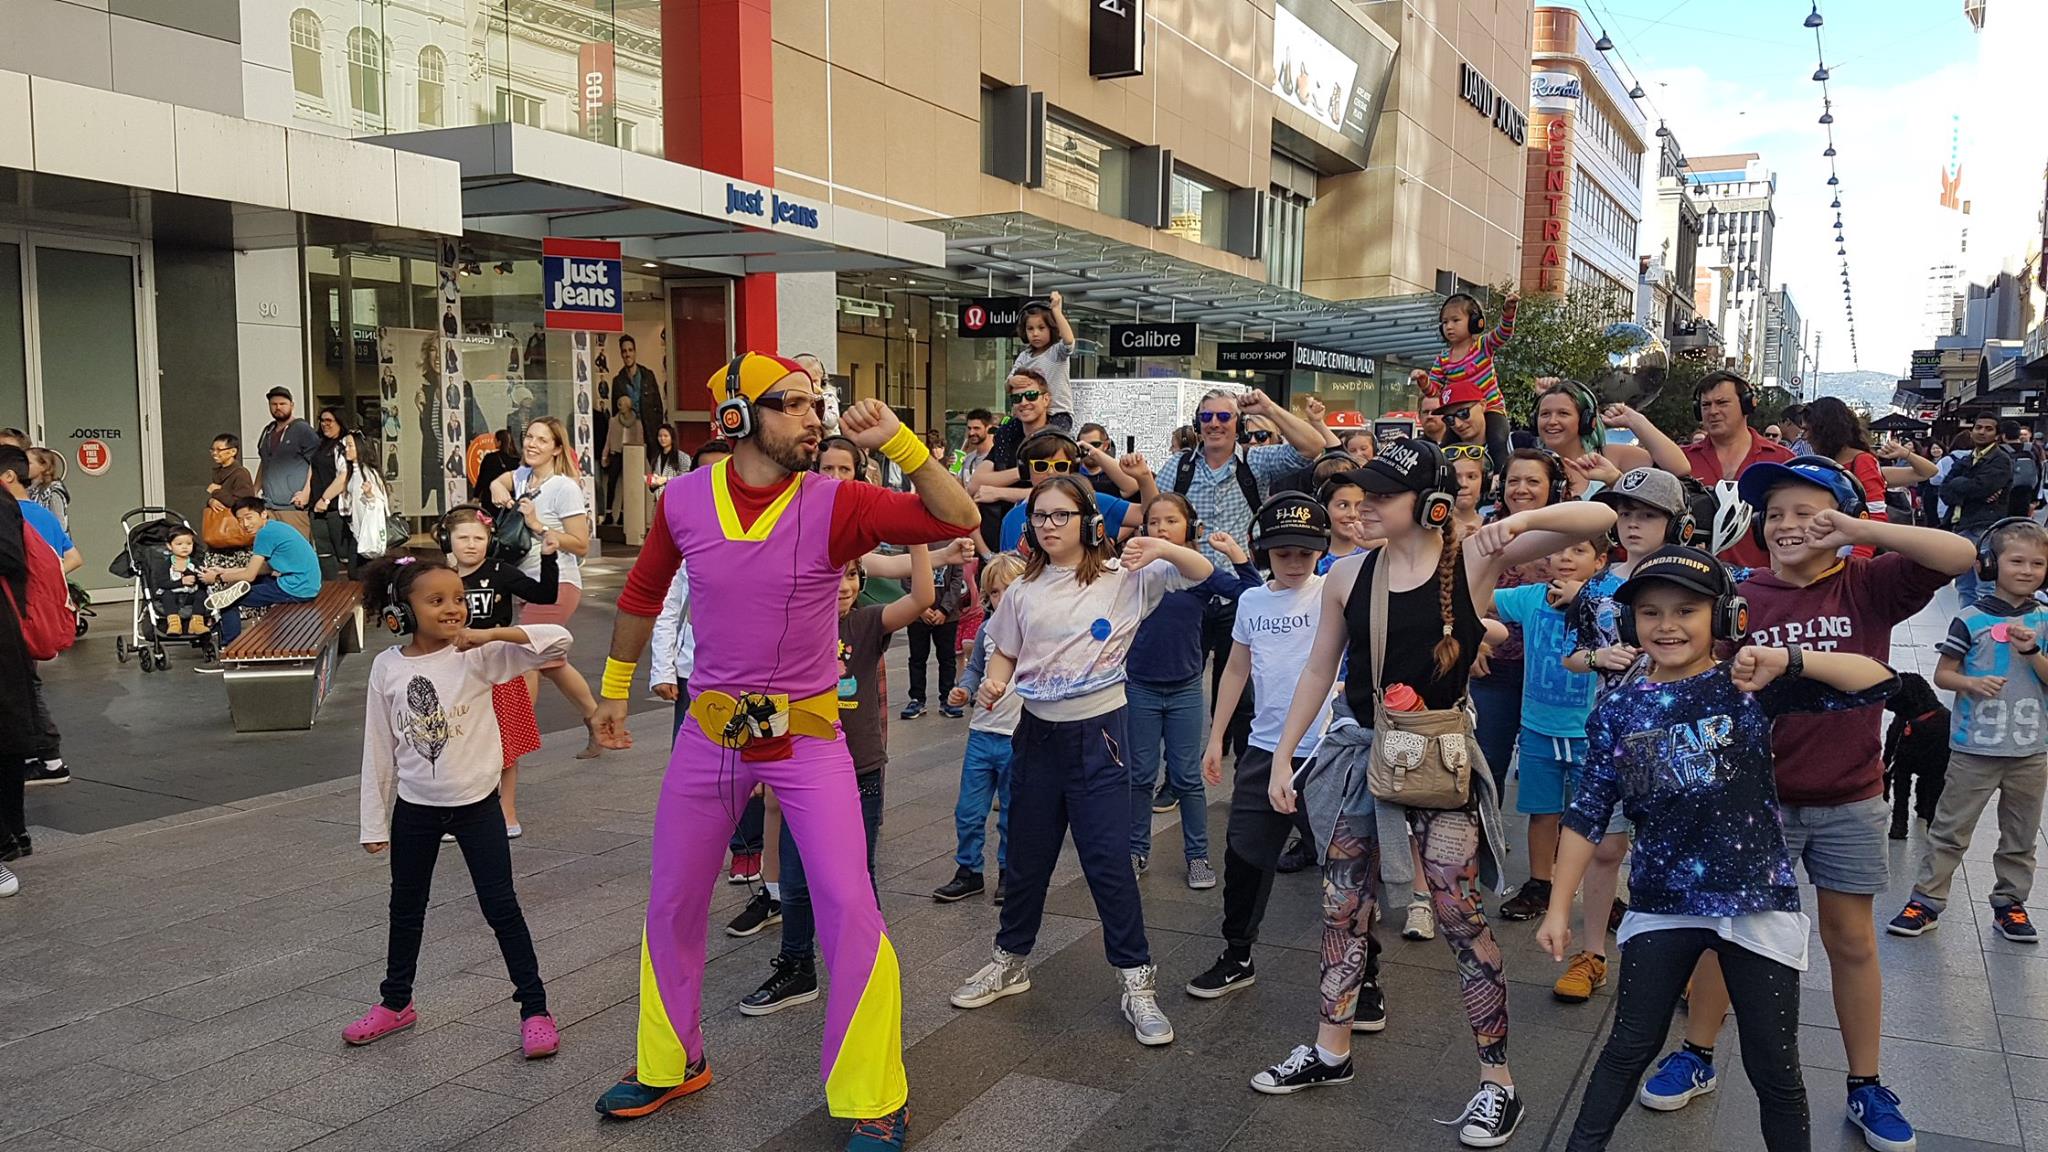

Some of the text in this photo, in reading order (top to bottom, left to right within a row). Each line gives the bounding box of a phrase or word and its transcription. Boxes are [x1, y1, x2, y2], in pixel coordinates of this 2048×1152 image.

[1461, 63, 1525, 146] DAVID JONES
[725, 183, 819, 229] Just Jeans
[1540, 119, 1567, 291] CENTRAL
[561, 258, 609, 287] Just
[552, 280, 616, 309] Jeans
[258, 302, 280, 318] 90
[989, 310, 1020, 324] lulul
[1121, 330, 1181, 348] Calibre
[1222, 351, 1287, 360] THE BODY SHOP
[1327, 352, 1357, 372] CENTRAL
[1357, 357, 1375, 374] PLAZA
[1248, 613, 1311, 634] Maggot
[1751, 616, 1852, 648] PIPING
[1973, 698, 2041, 746] 99
